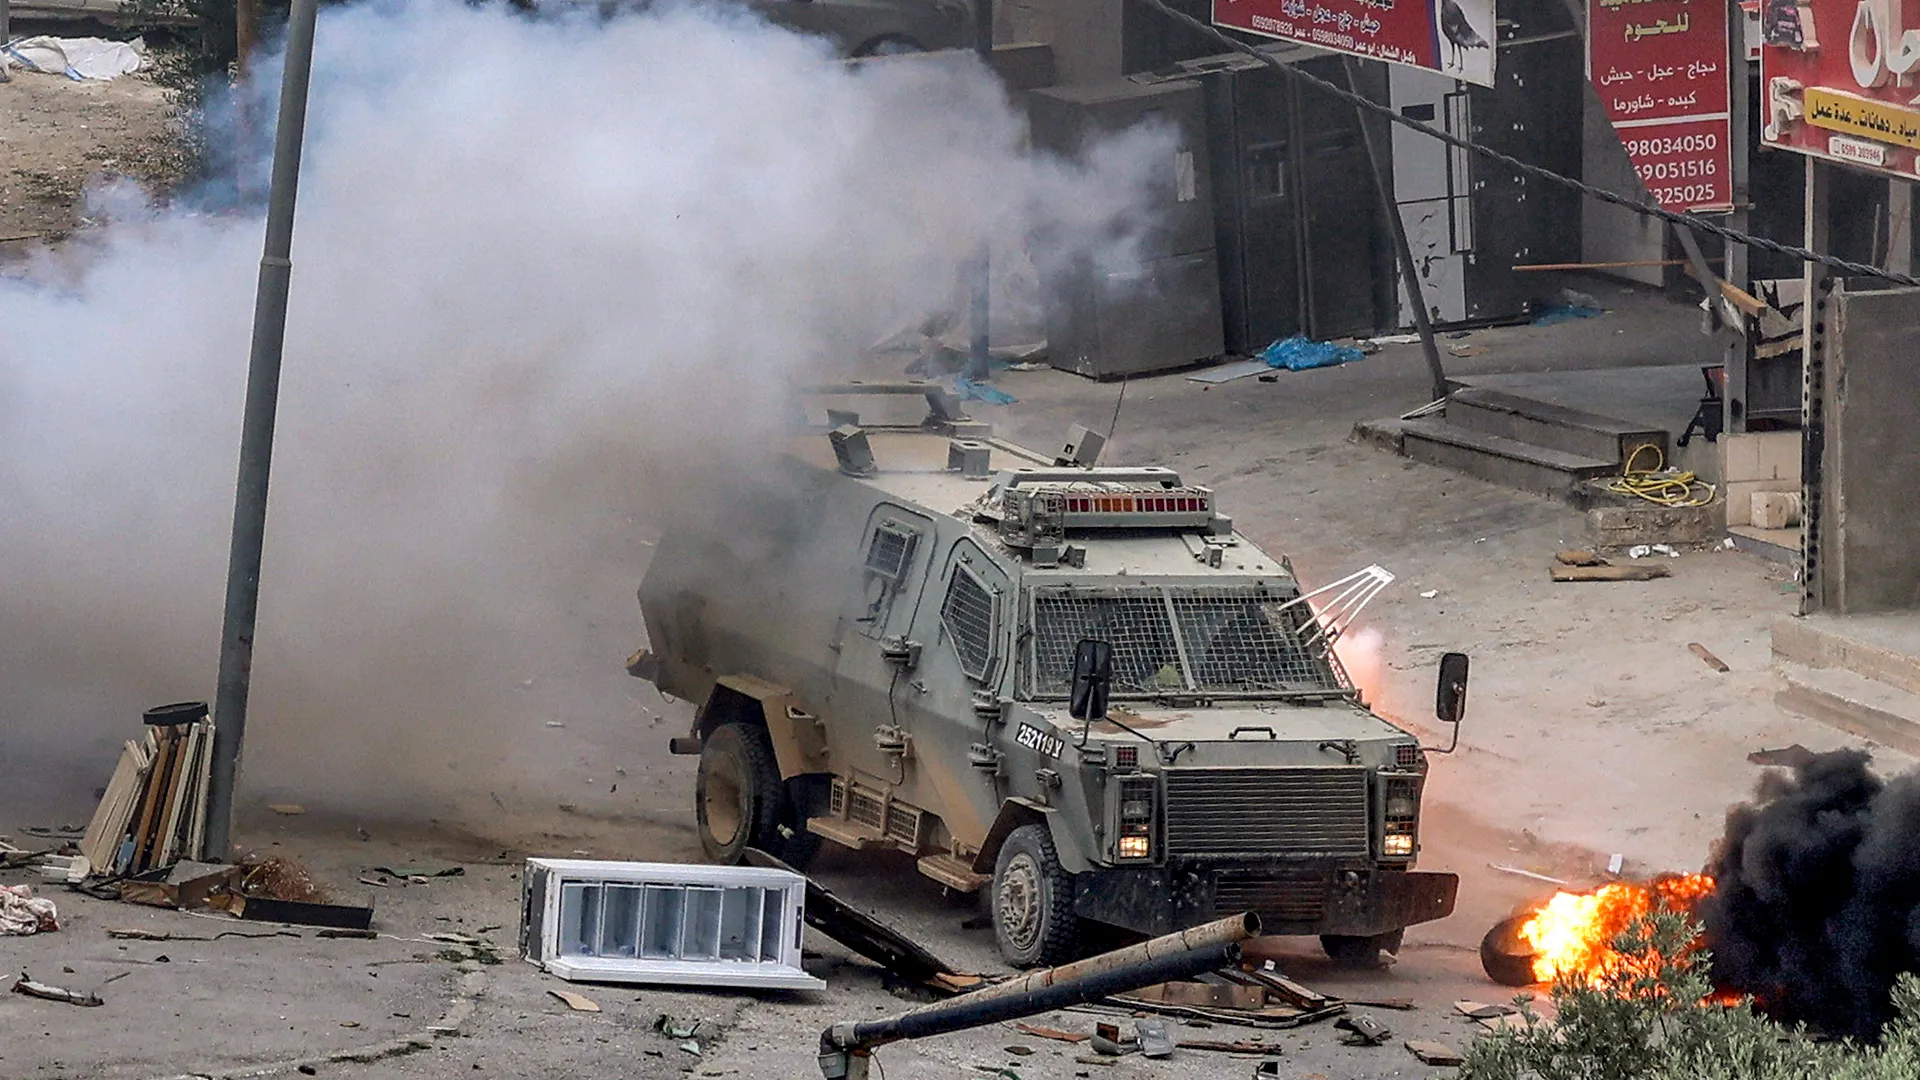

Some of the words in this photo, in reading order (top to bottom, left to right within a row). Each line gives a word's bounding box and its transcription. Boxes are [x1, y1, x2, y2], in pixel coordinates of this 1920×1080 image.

[1624, 12, 1689, 43] للحوم
[1600, 66, 1633, 86] حبش
[1647, 64, 1674, 81] عجل
[1687, 60, 1716, 79] دجاج
[1614, 94, 1654, 114] شاورما
[1649, 183, 1715, 204] 325025
[1017, 724, 1055, 755] 252119
